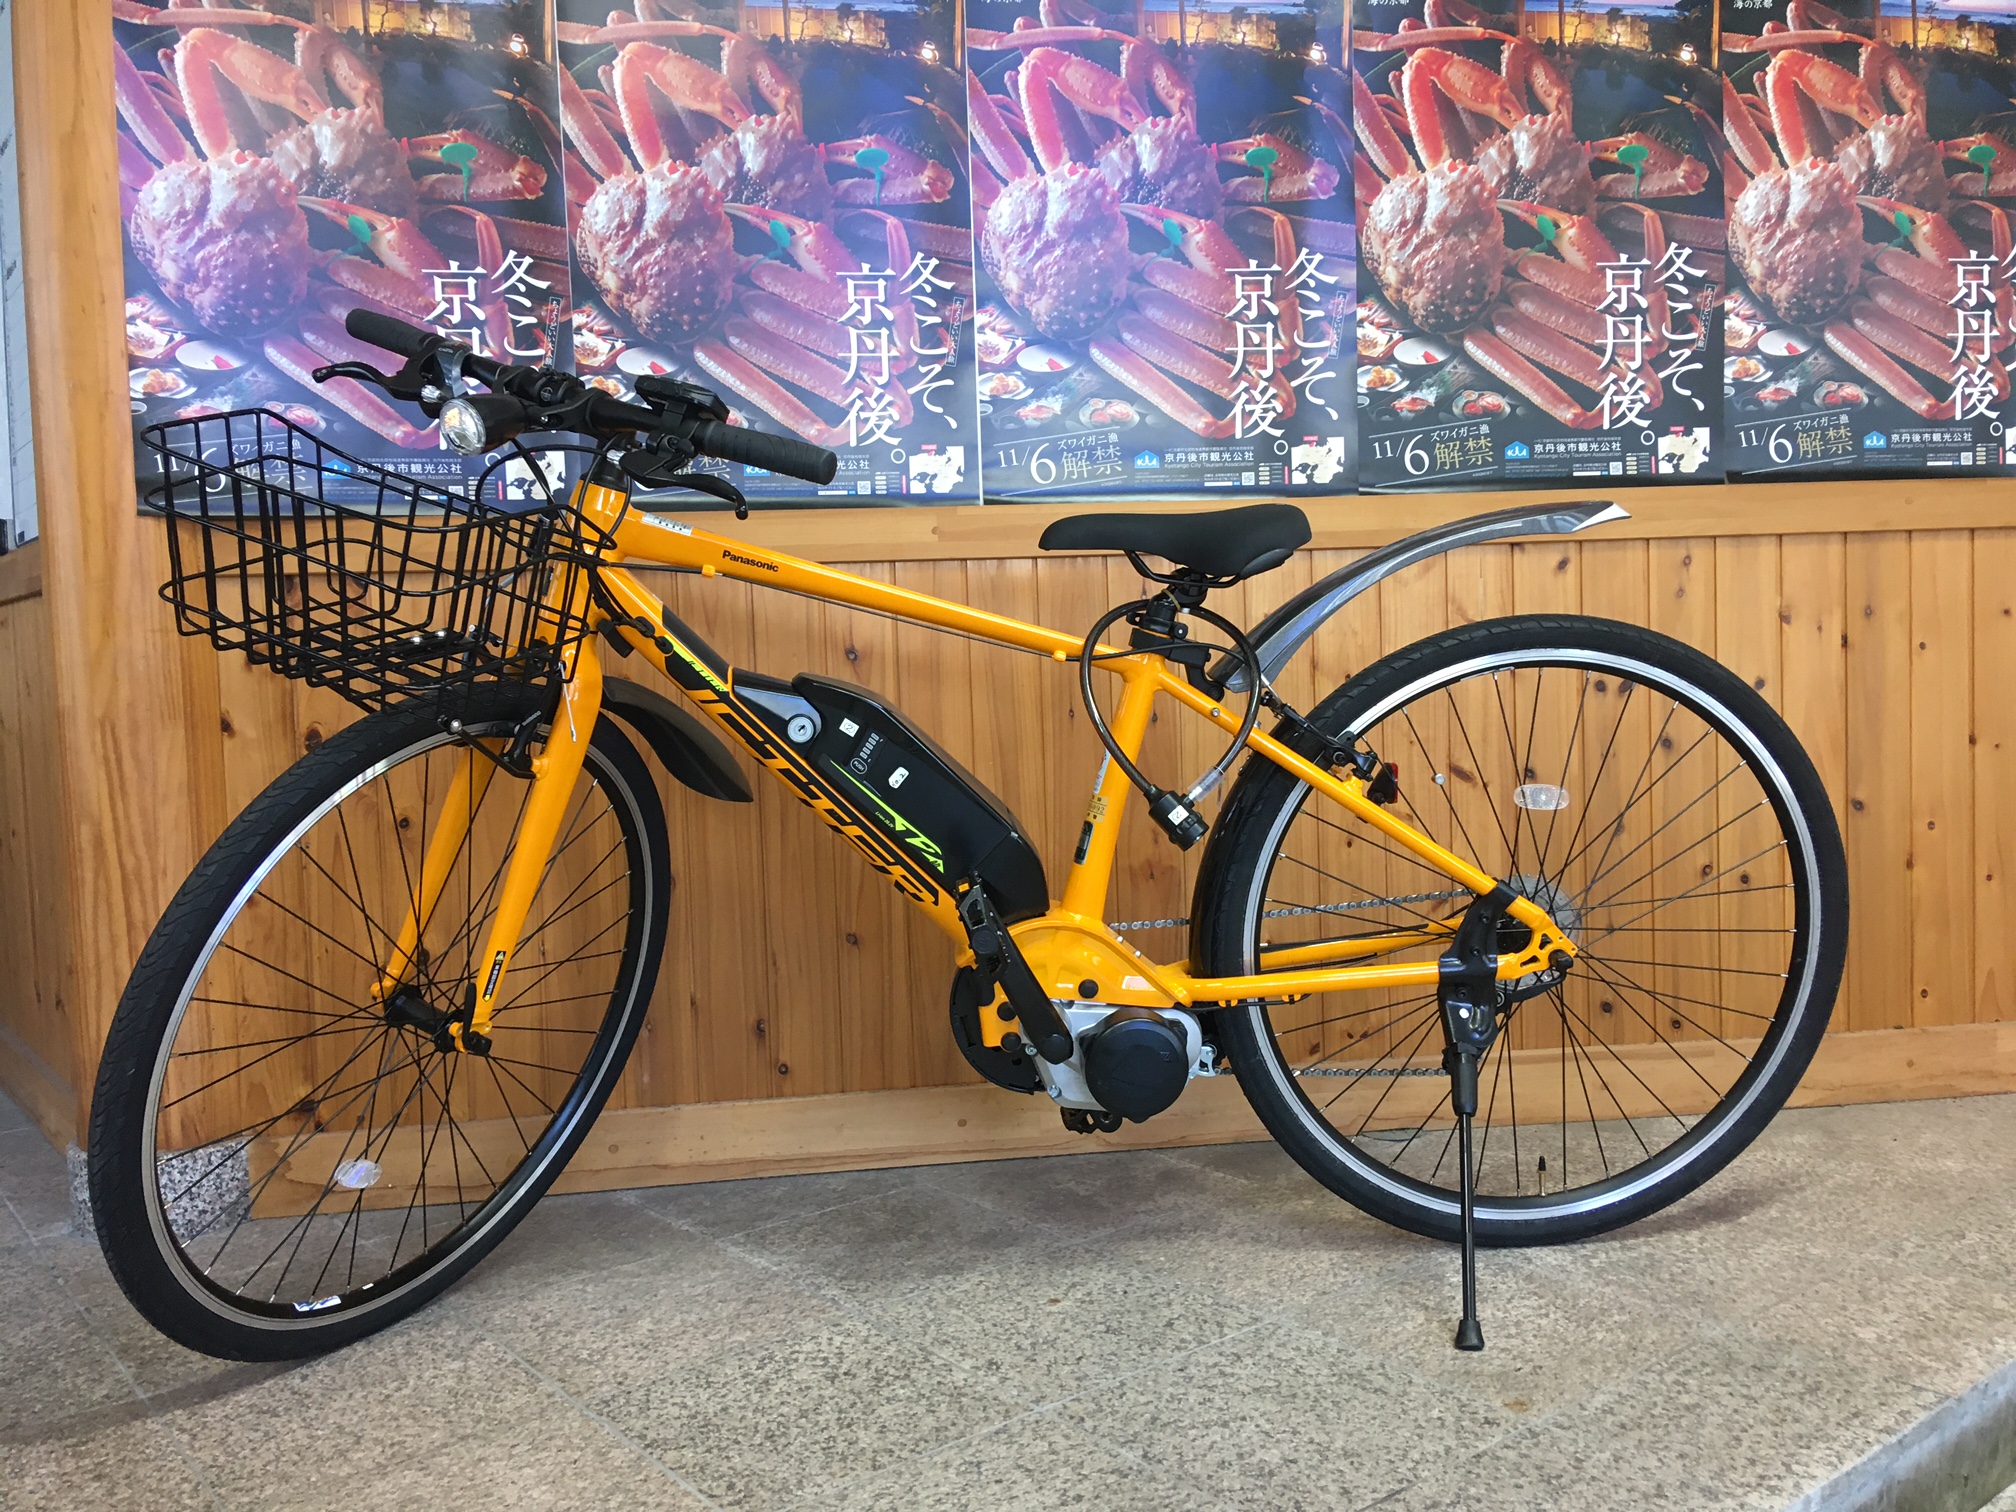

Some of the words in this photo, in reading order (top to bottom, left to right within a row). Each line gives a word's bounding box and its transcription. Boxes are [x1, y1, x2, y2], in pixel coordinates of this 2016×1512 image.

[899, 251, 958, 430] 冬こそ、
[1284, 247, 1339, 421] 冬こそ、
[1653, 241, 1708, 412] 冬こそ、
[1947, 249, 2003, 436] 京丹後。
[836, 262, 906, 464] 京丹後。
[1225, 259, 1289, 456] 京丹後。
[1594, 253, 1655, 446] 京丹後。
[1430, 423, 1490, 442] ズワイガニ漁
[1793, 414, 1849, 432] ズワイガニ漁
[1890, 432, 1973, 443] 京丹後市観光公社
[1057, 432, 1119, 451] ズワイガニ漁
[1164, 451, 1254, 463] 京丹後市観光公社
[1434, 436, 1494, 472] 解禁
[1533, 441, 1622, 453] 京丹後市観光公社
[1796, 426, 1853, 460] 解禁
[1060, 445, 1123, 481] 解禁
[721, 549, 780, 573] Panasonic
